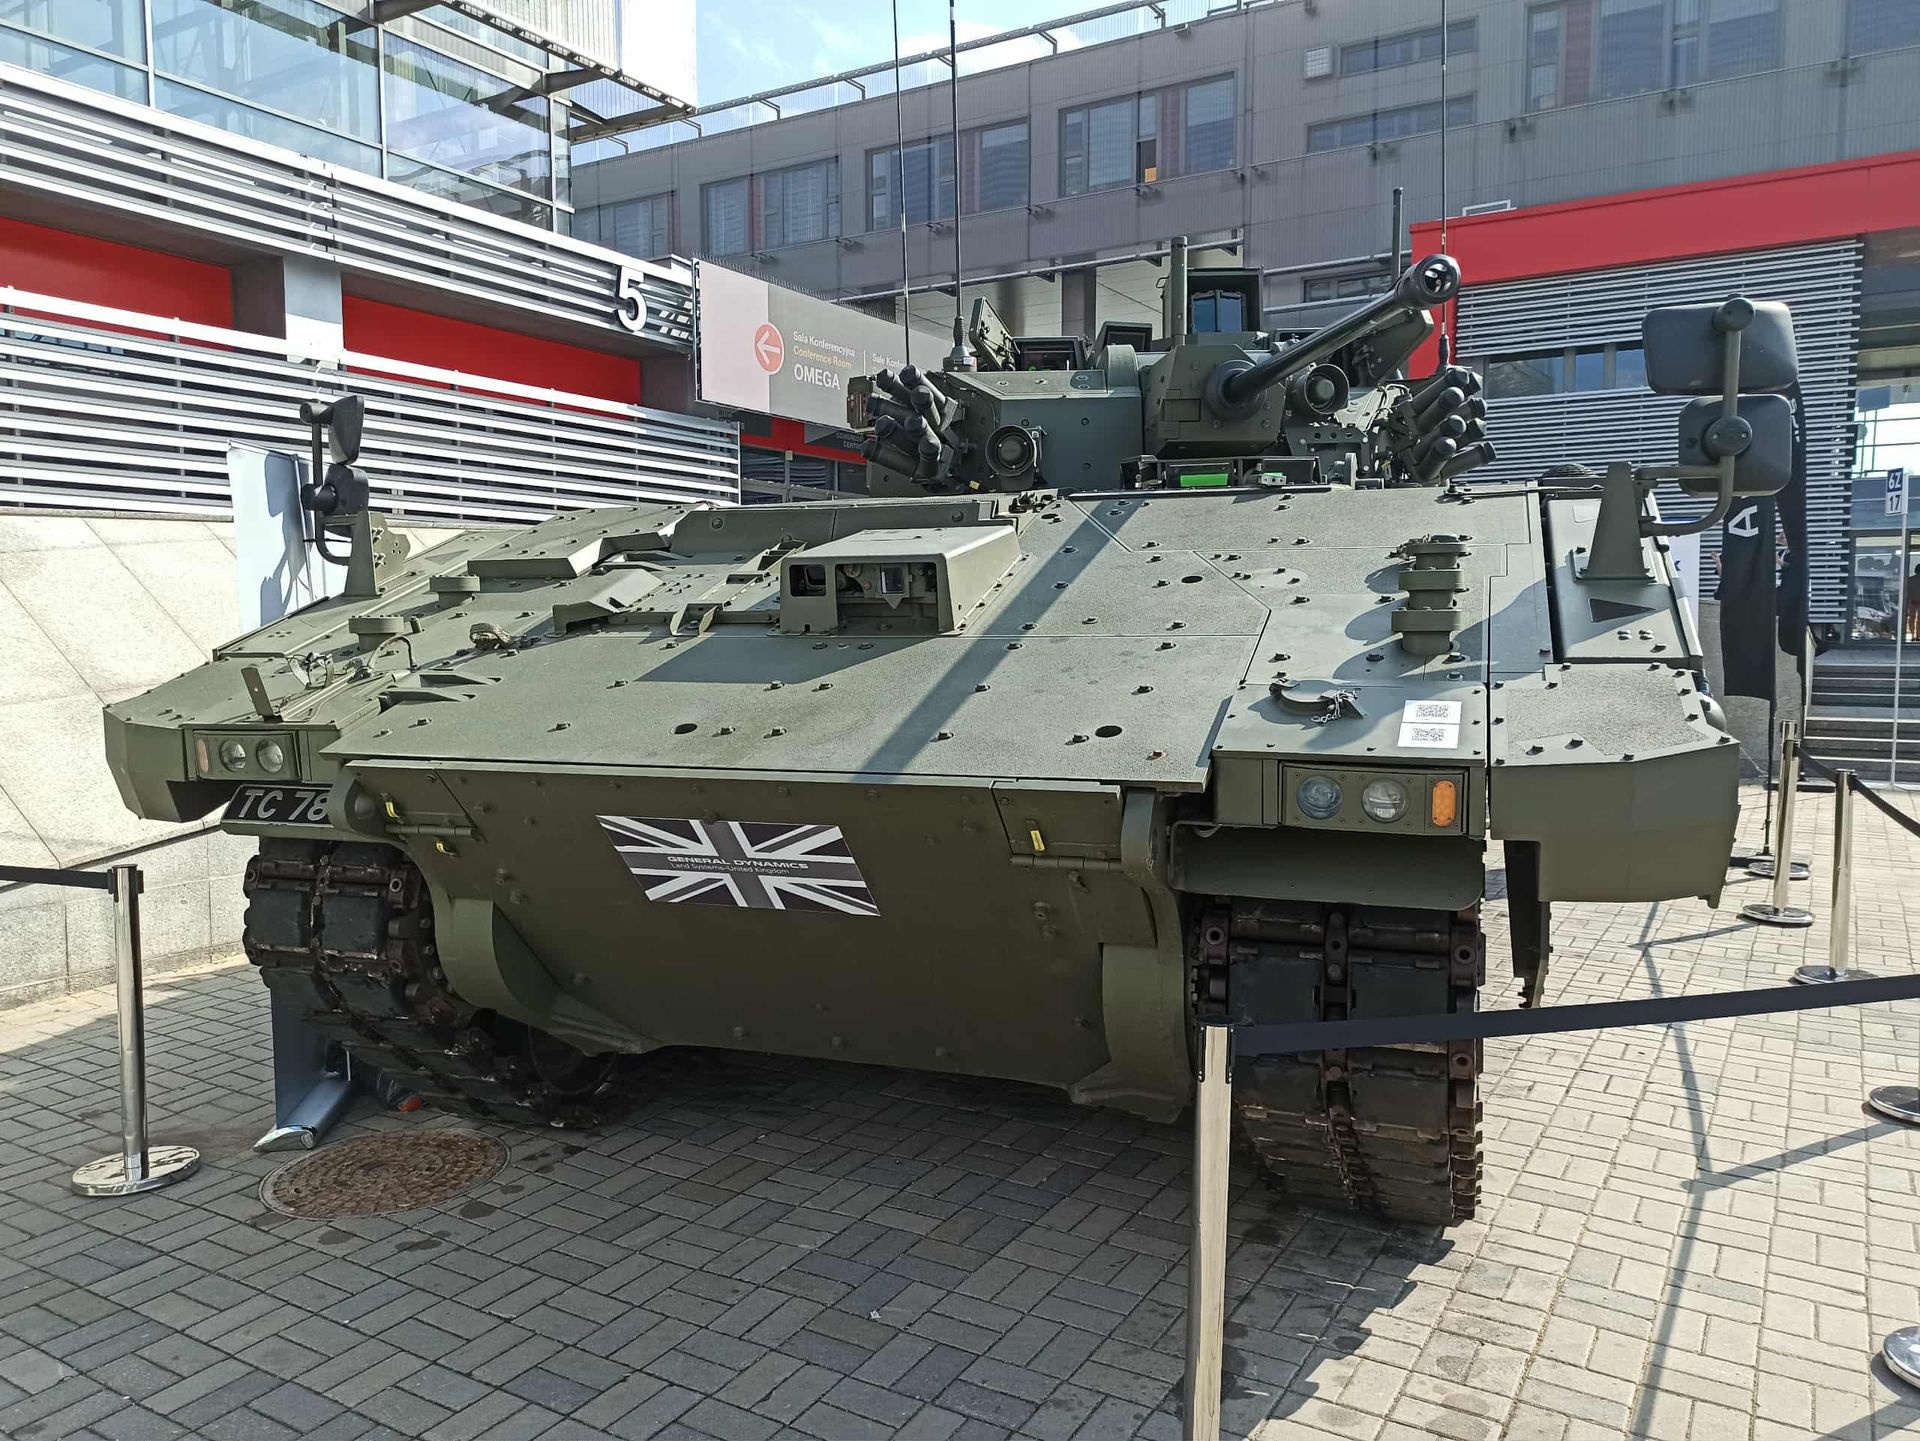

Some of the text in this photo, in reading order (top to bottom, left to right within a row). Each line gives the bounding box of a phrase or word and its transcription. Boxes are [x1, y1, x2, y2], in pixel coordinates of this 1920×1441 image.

[618, 266, 647, 331] 5
[793, 331, 855, 357] Sala Konferencyjna
[793, 345, 852, 369] Conference Room
[872, 353, 885, 365] Sale
[794, 364, 840, 390] OMEGA
[1889, 494, 1902, 511] 17
[238, 789, 284, 819] TC
[667, 856, 809, 870] GENERAL DYNAMICS
[754, 867, 790, 876] Kingdom
